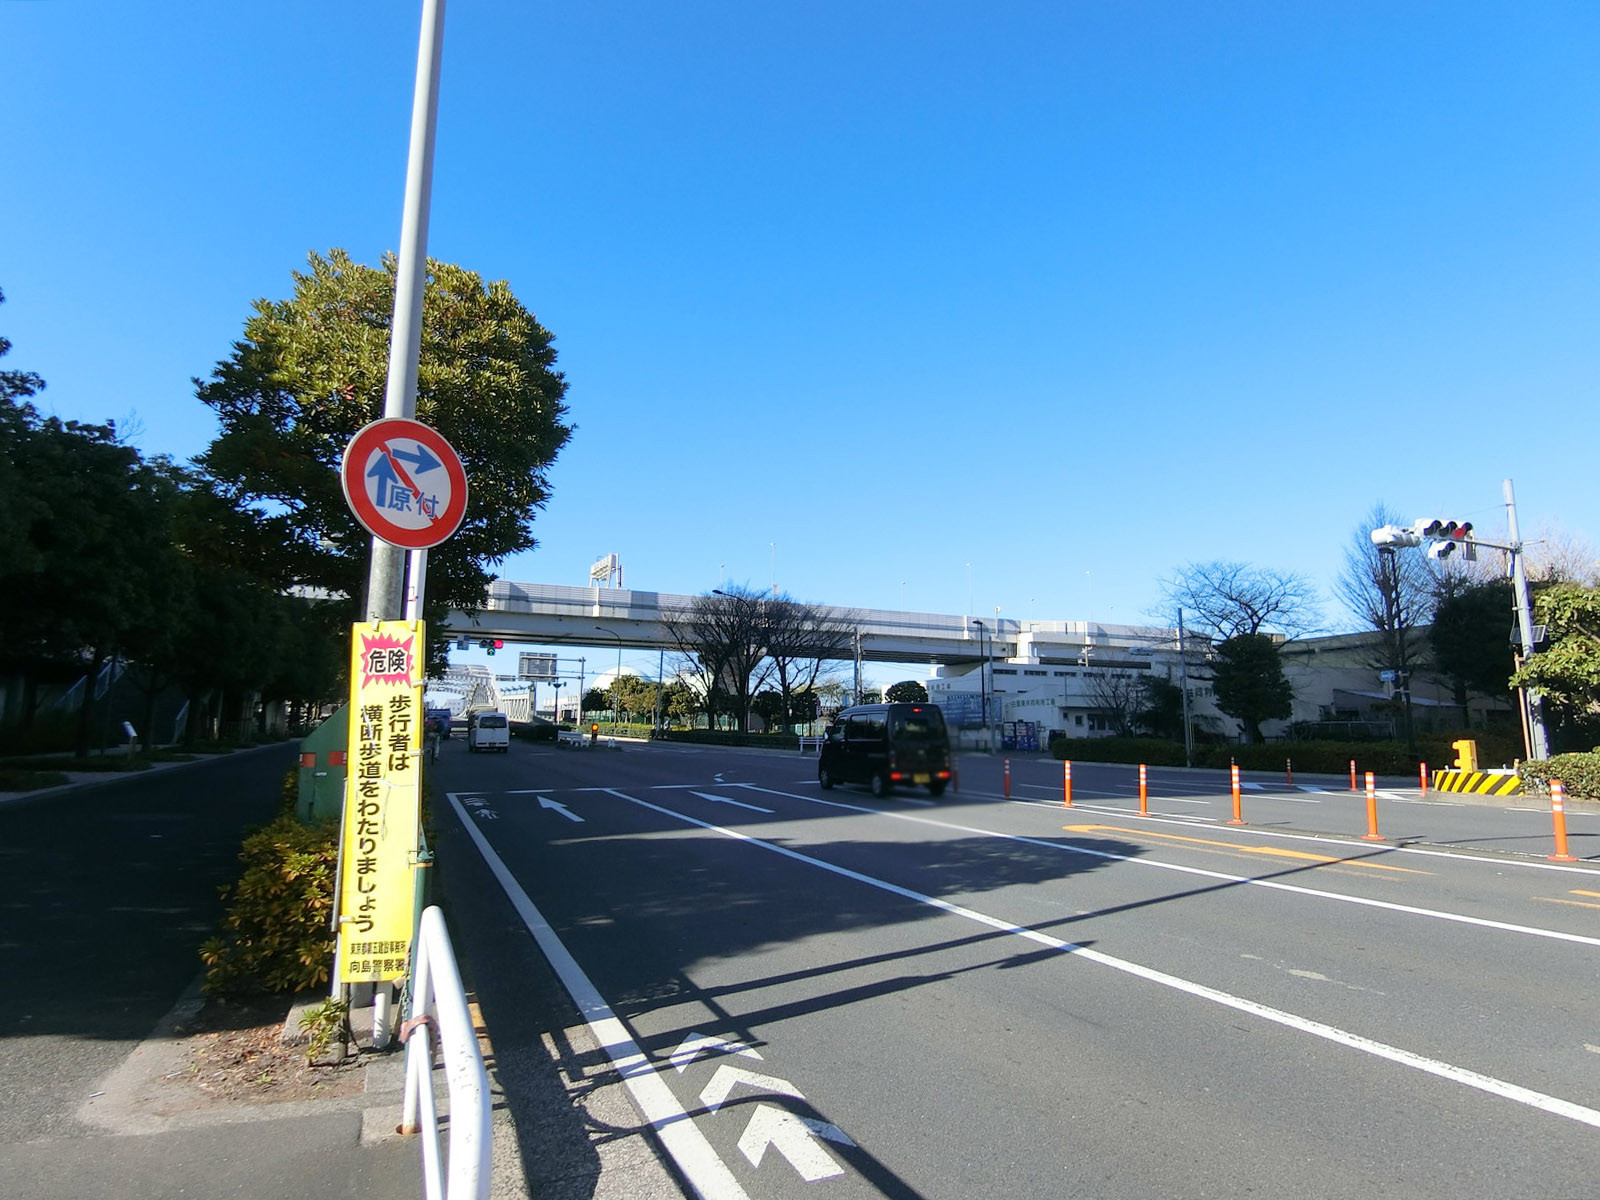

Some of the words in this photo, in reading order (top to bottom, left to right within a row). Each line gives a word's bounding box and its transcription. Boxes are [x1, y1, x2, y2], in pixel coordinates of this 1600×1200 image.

[388, 484, 439, 518] 原付
[369, 649, 407, 673] 危険
[388, 694, 412, 772] 歩行者は
[354, 705, 384, 933] 横断歩道をわたりましょう
[349, 958, 406, 973] 向島警察署
